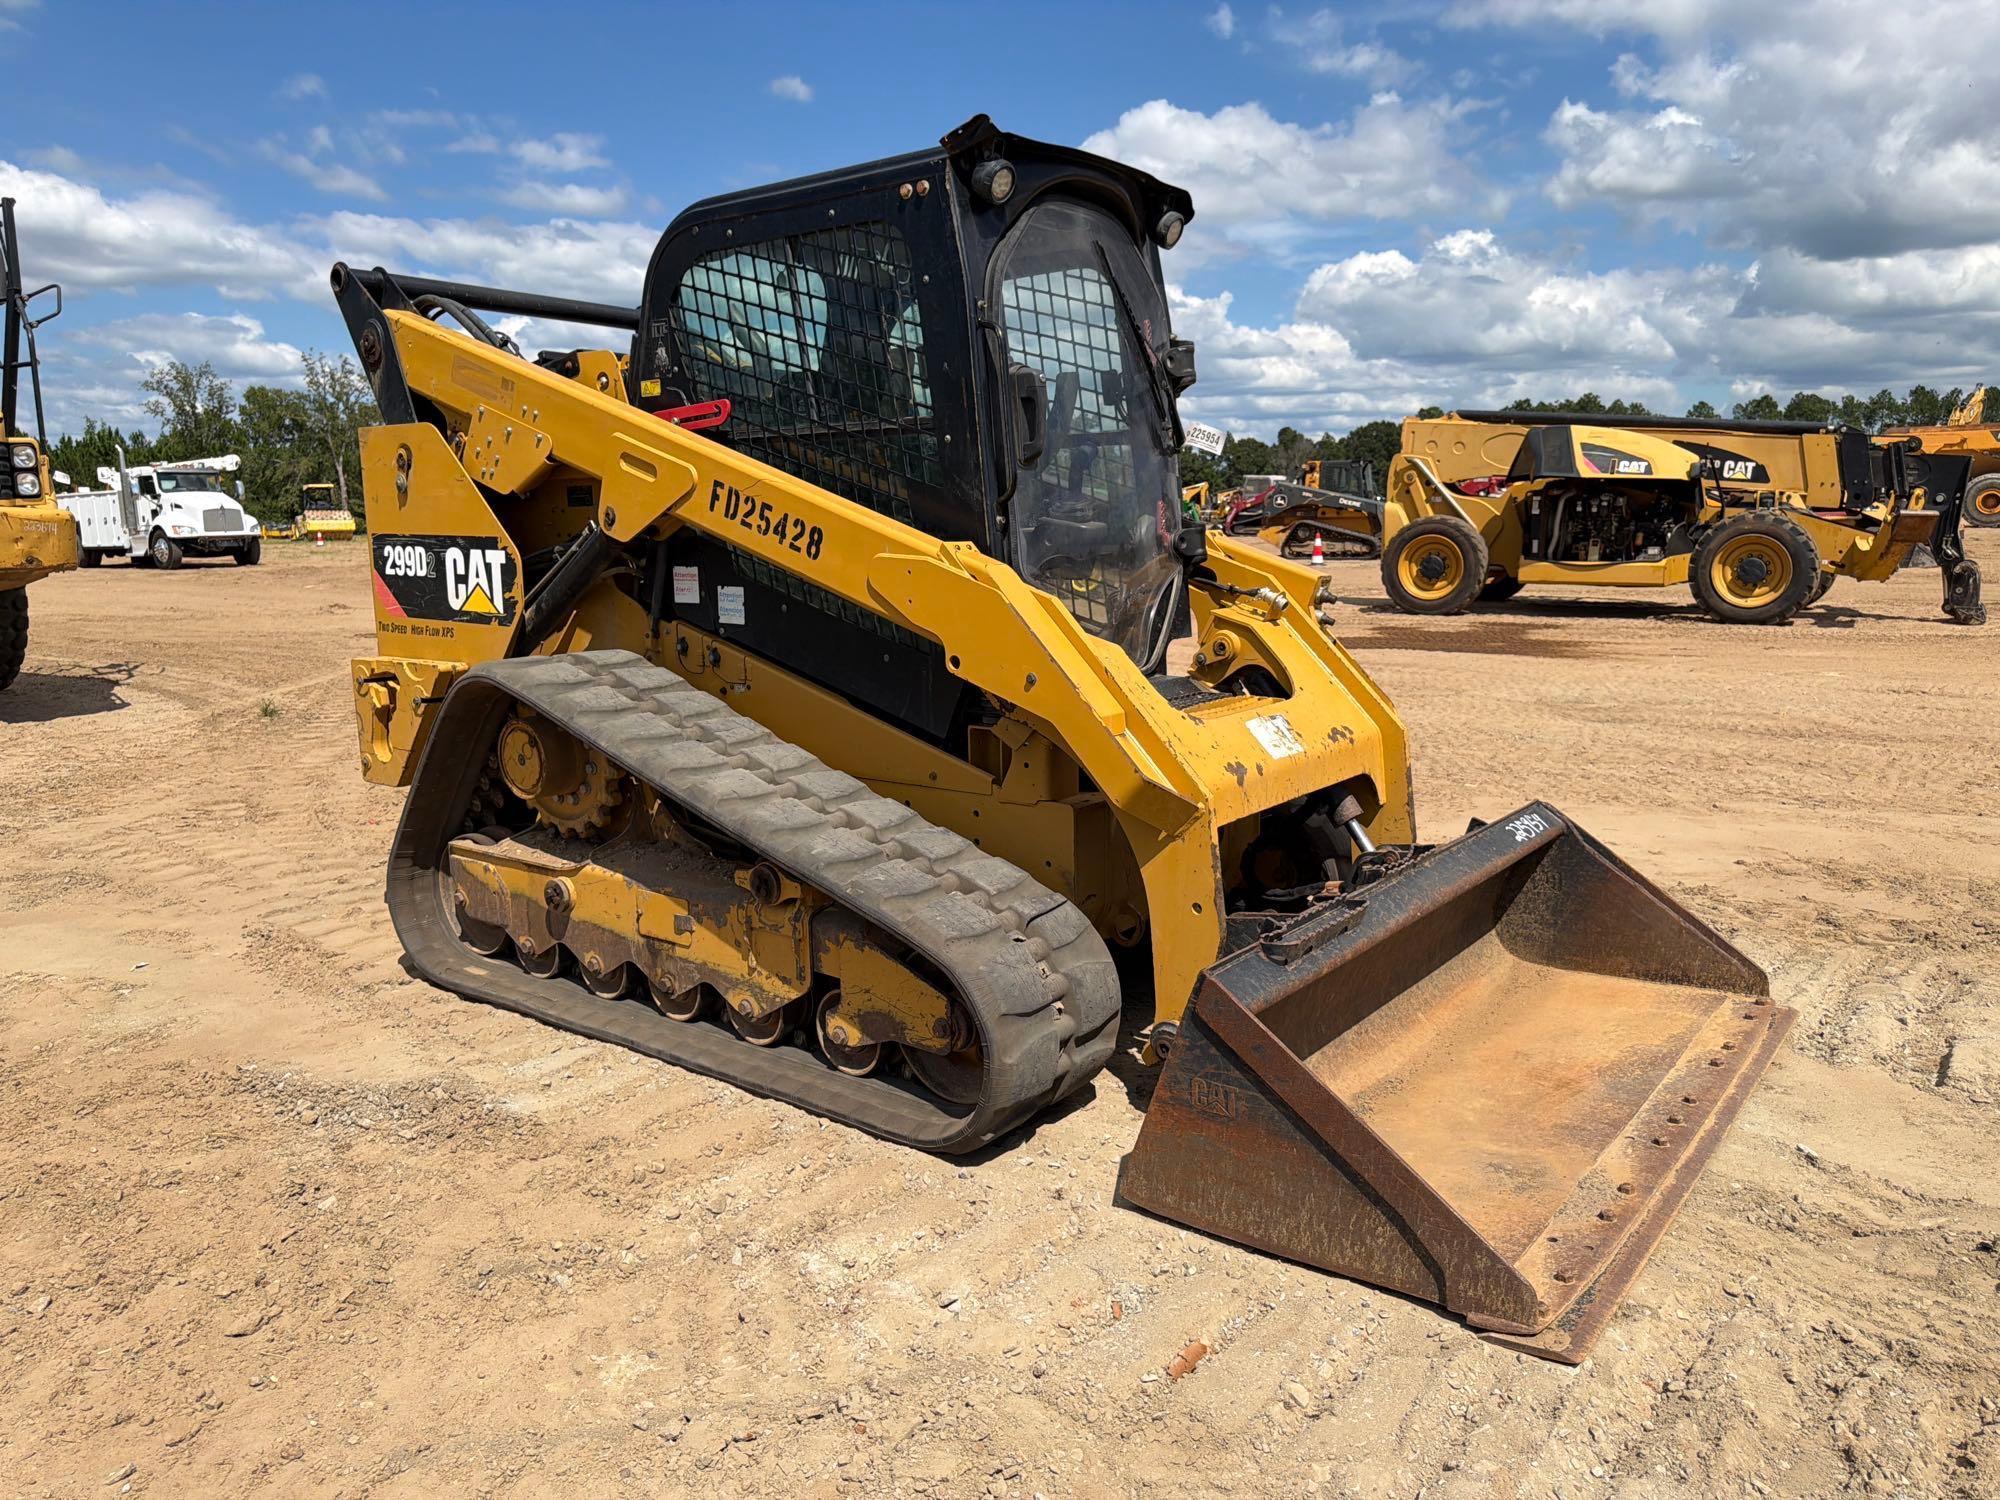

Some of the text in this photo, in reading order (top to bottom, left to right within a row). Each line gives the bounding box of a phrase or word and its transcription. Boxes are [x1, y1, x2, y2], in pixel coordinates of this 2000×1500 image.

[1190, 427, 1221, 447] 225954
[1619, 460, 1648, 473] CAT
[1722, 460, 1756, 479] CAT
[1338, 497, 1362, 508] DEERE
[709, 479, 824, 560] FD25428
[445, 546, 506, 615] CAT
[390, 623, 408, 635] SPEED
[410, 624, 424, 636] HIGH
[425, 625, 440, 637] FLOW
[441, 627, 455, 638] XPS
[1190, 1077, 1239, 1120] CAT
